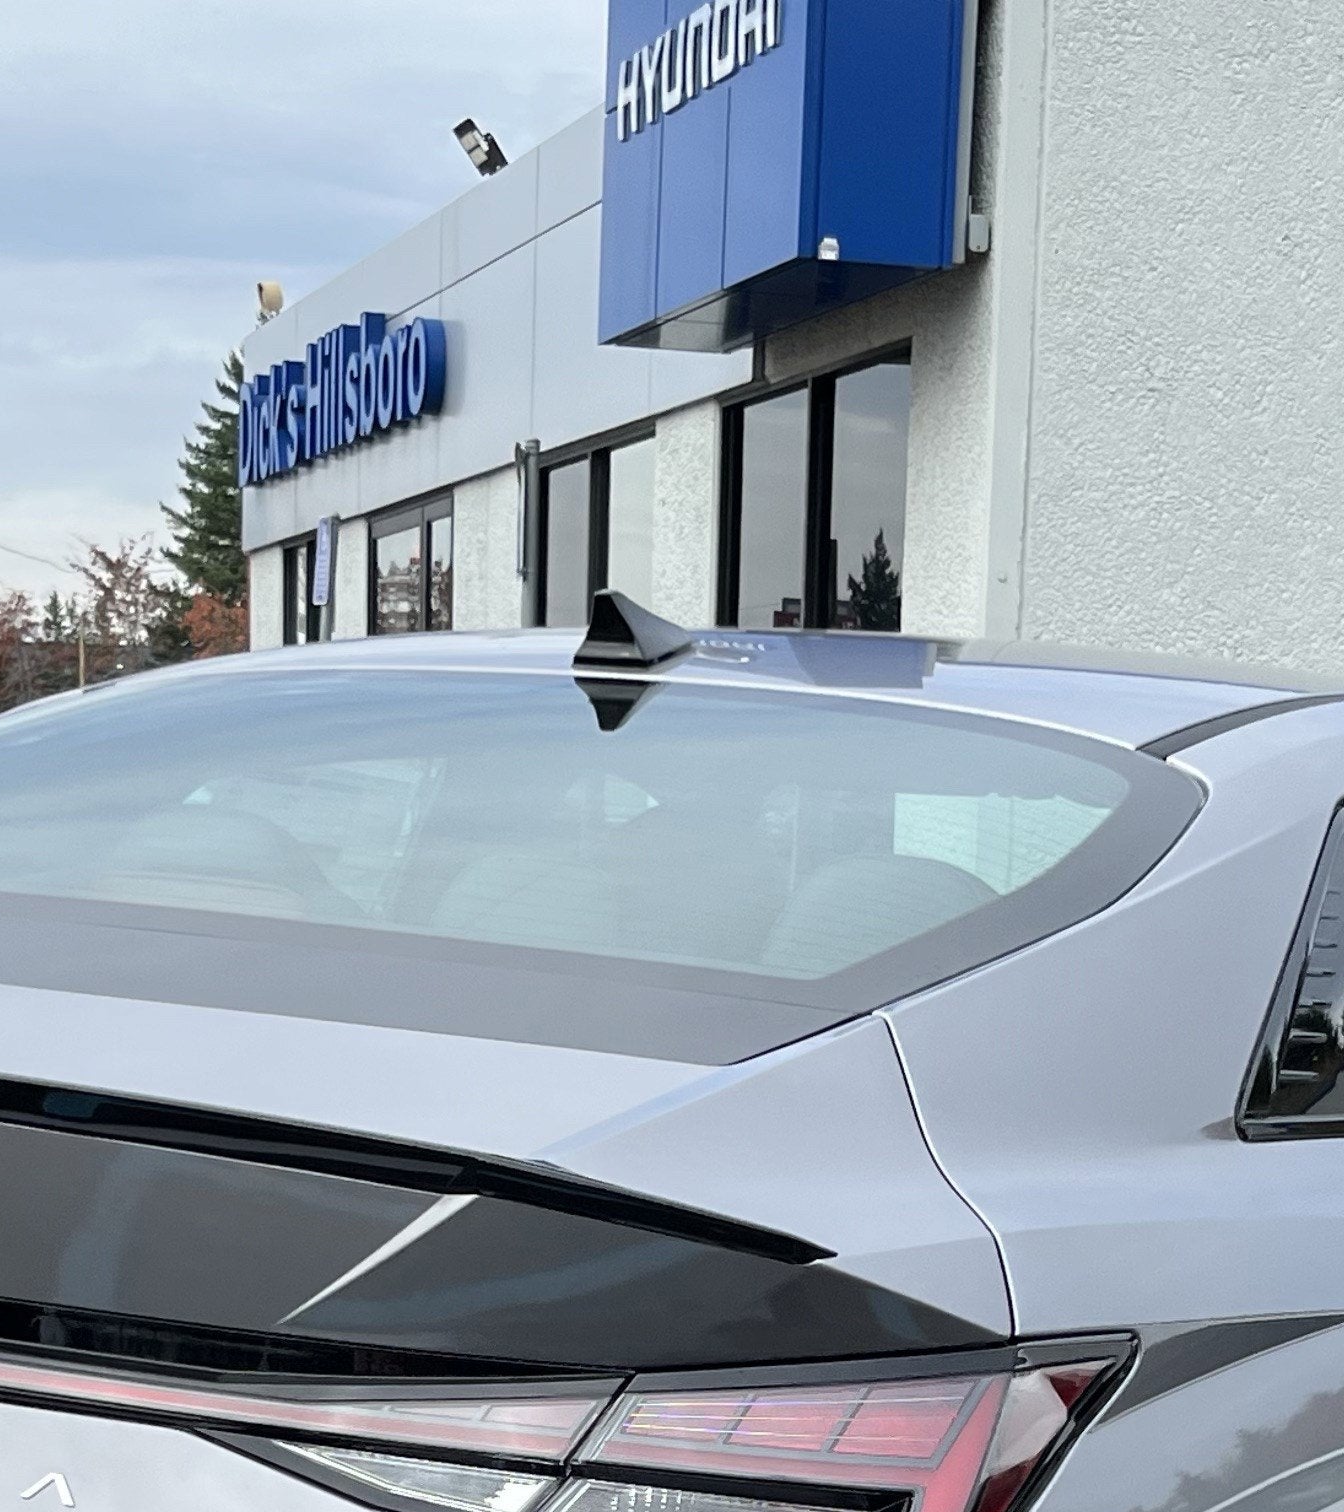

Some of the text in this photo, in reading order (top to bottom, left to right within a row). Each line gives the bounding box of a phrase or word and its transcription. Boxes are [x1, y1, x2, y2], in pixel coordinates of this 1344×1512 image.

[617, 0, 779, 142] HYUNDAI
[238, 312, 428, 488] Dick's Hillsboro
